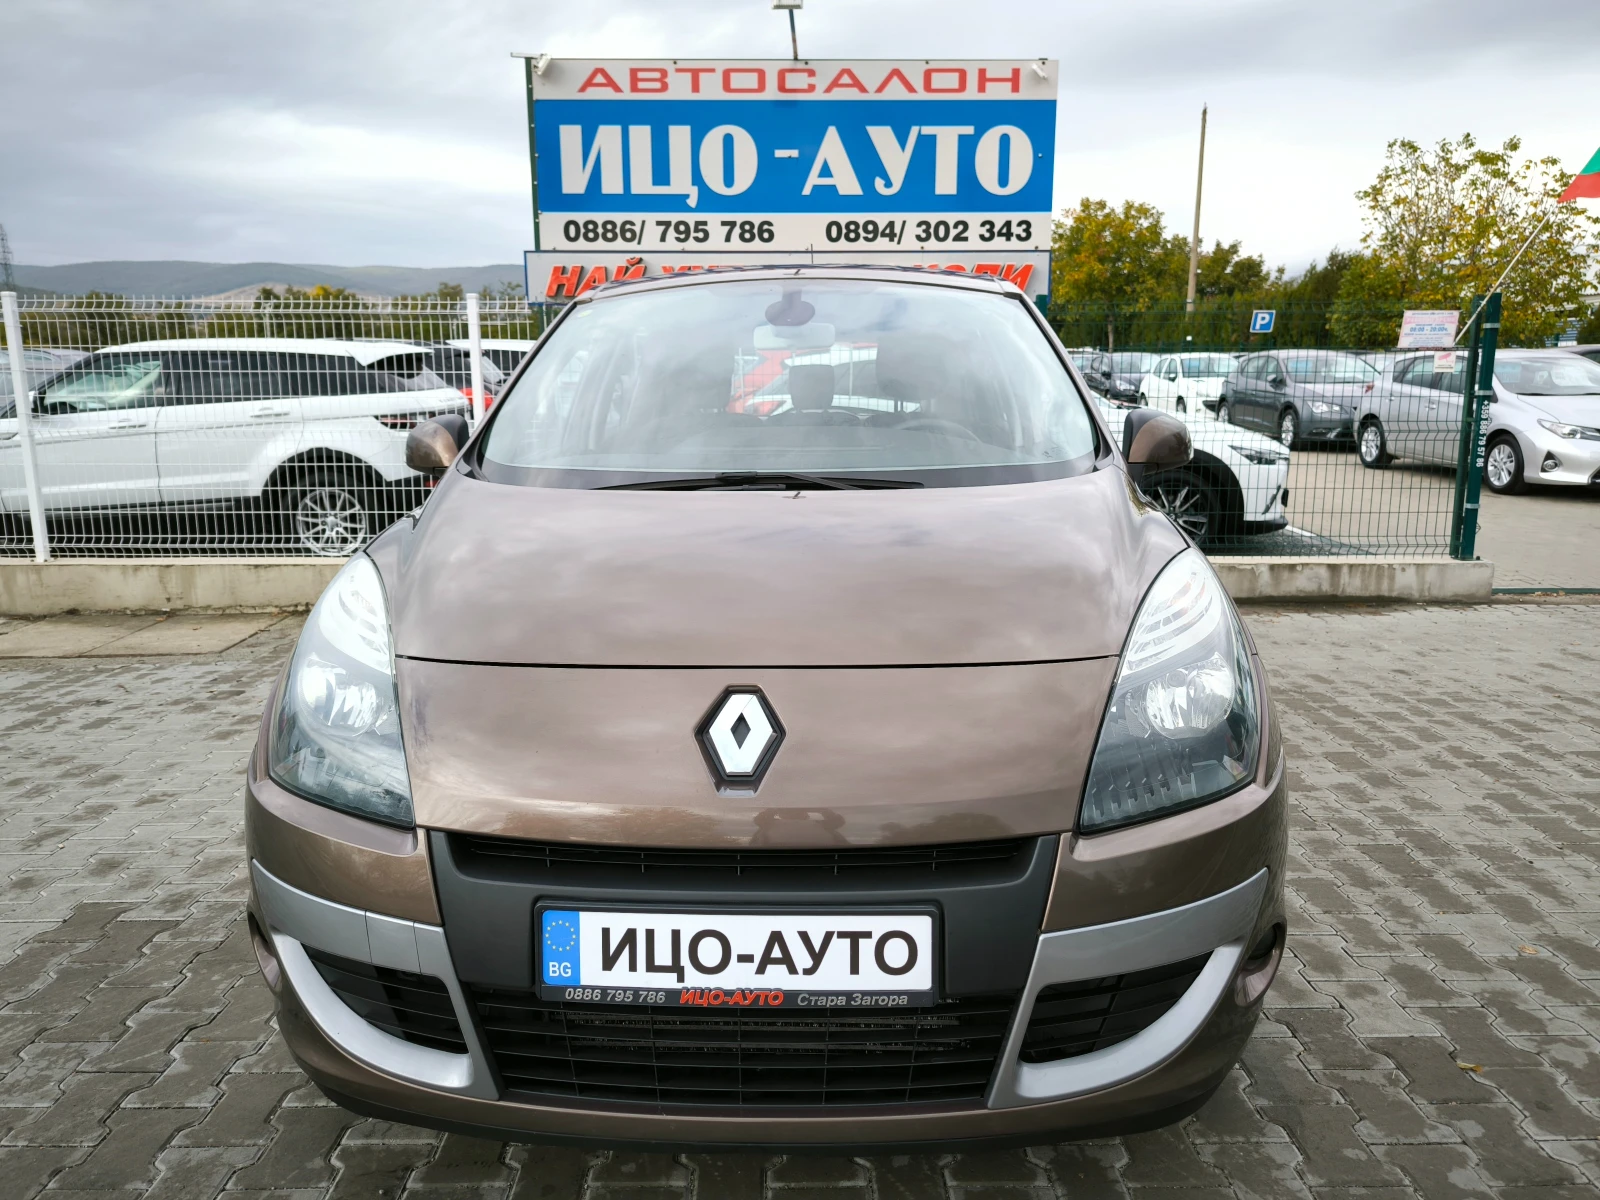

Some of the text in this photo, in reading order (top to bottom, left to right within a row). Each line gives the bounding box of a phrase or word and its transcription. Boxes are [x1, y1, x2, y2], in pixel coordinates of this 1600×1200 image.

[577, 67, 1021, 94] АВТОСАЛОН
[563, 219, 1033, 245] 0886/ 795 786 0894/ 302 343
[1255, 313, 1270, 330] P
[1478, 435, 1487, 446] 79
[1476, 446, 1486, 457] 57
[601, 926, 919, 984] ИЦО-АУТО
[549, 962, 572, 977] BG
[565, 988, 666, 1004] 0886 795 786
[679, 987, 784, 1007] ИЦО-АУТО
[797, 992, 909, 1007] Стара Загора
